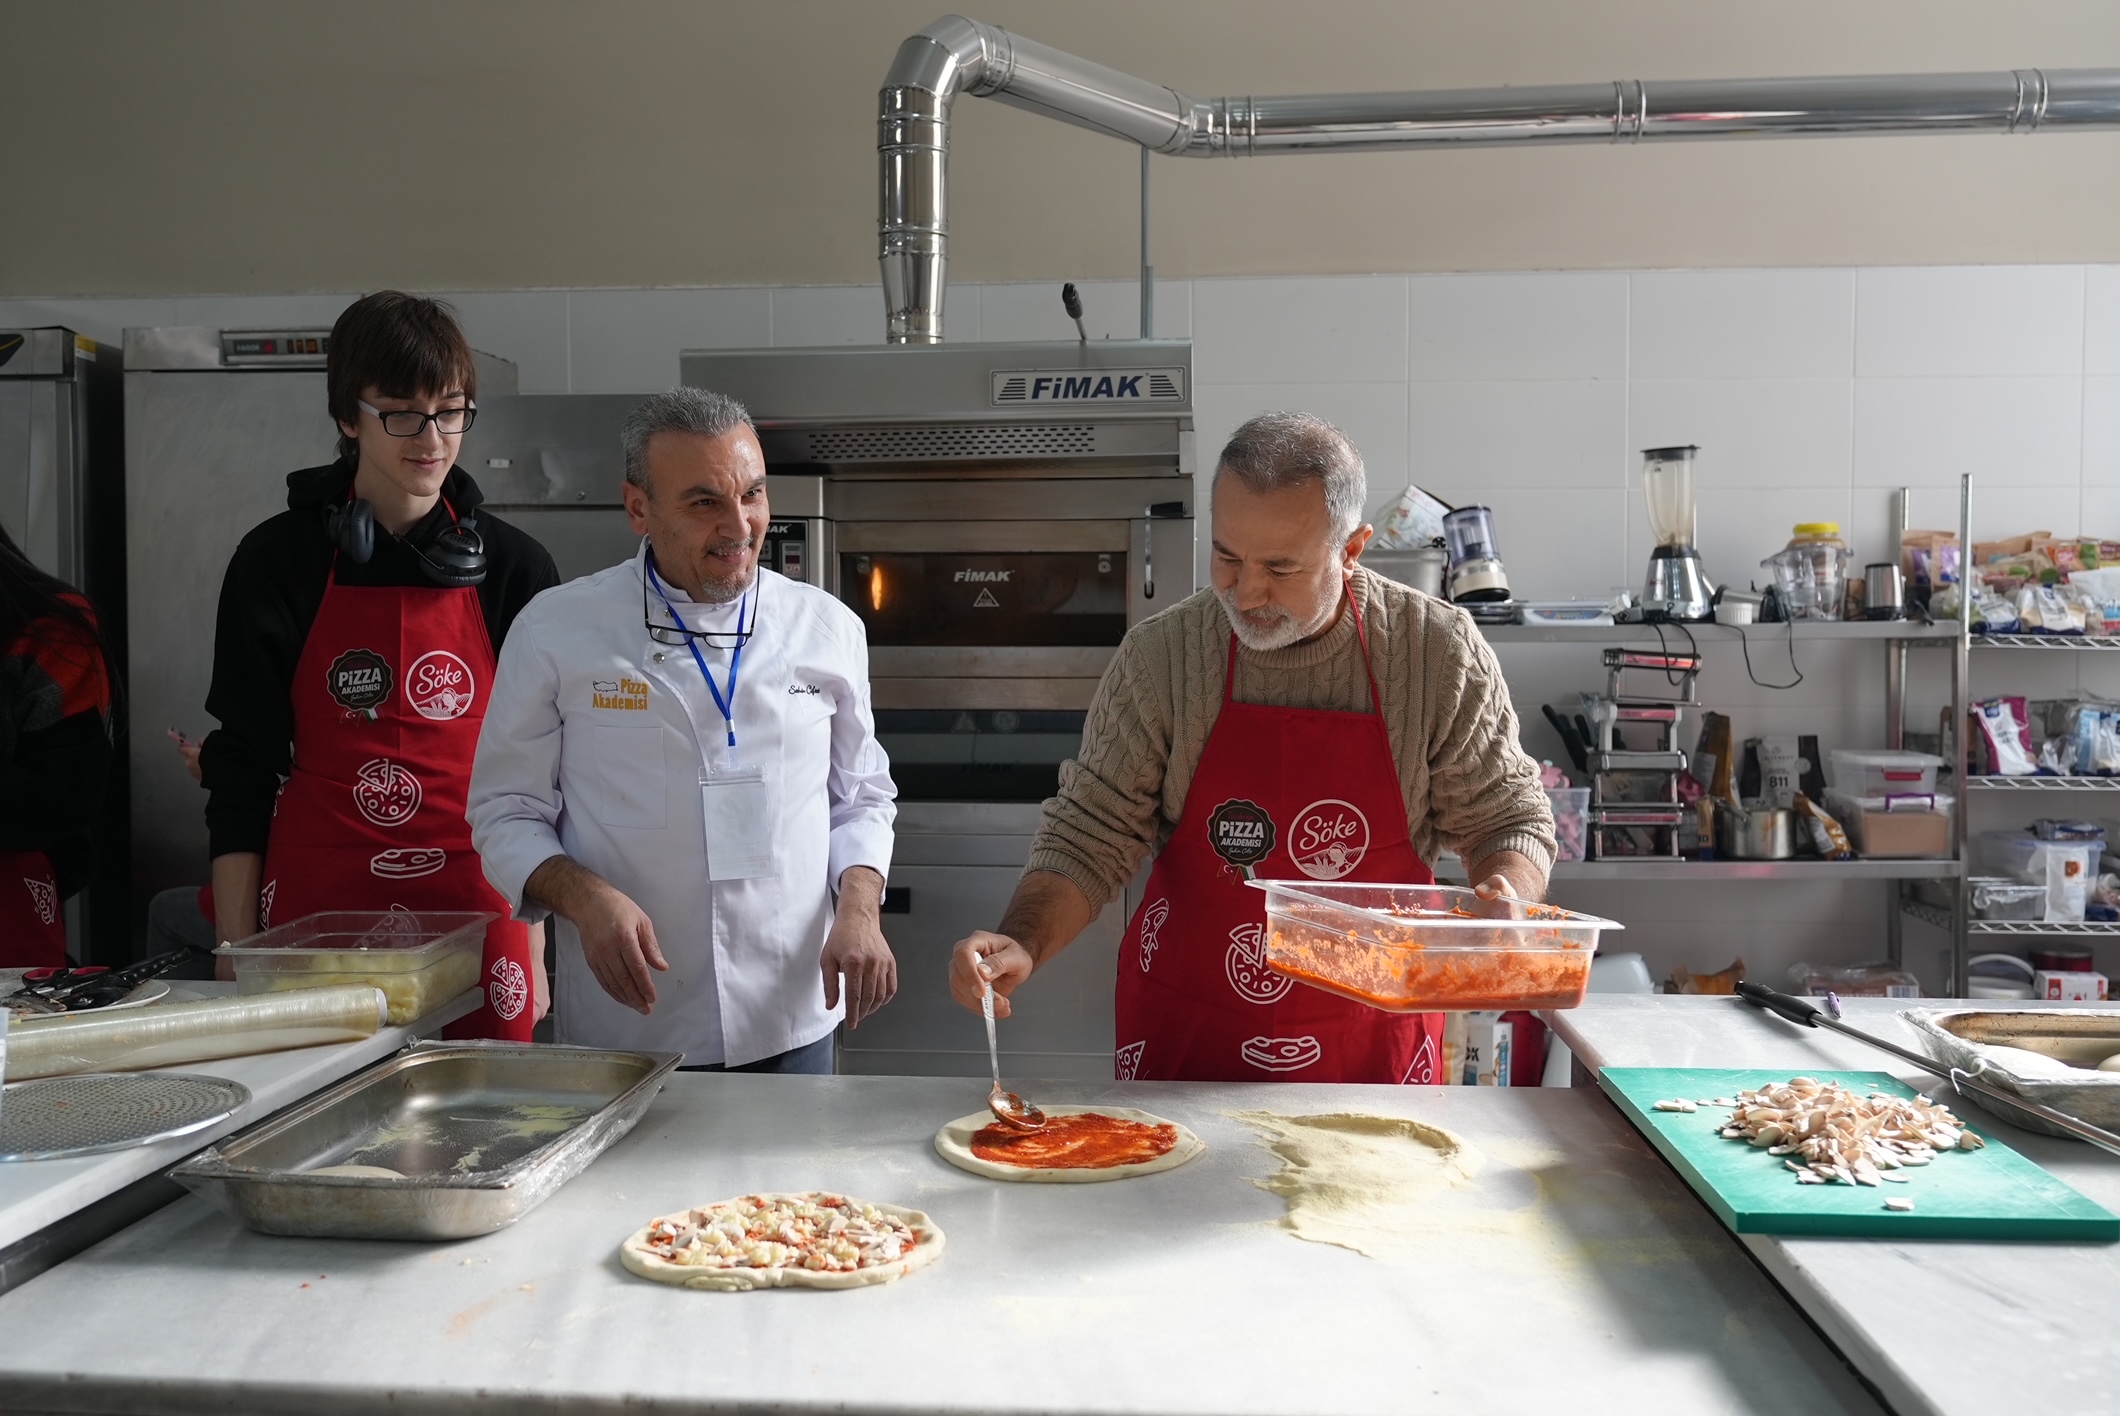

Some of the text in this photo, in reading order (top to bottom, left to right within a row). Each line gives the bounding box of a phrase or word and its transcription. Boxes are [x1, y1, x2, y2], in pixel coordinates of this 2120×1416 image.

[416, 663, 462, 694] Söke
[620, 678, 648, 694] Pizza
[592, 693, 648, 710] Akademisi
[1769, 776, 1788, 788] 811
[1300, 813, 1357, 850] Söke
